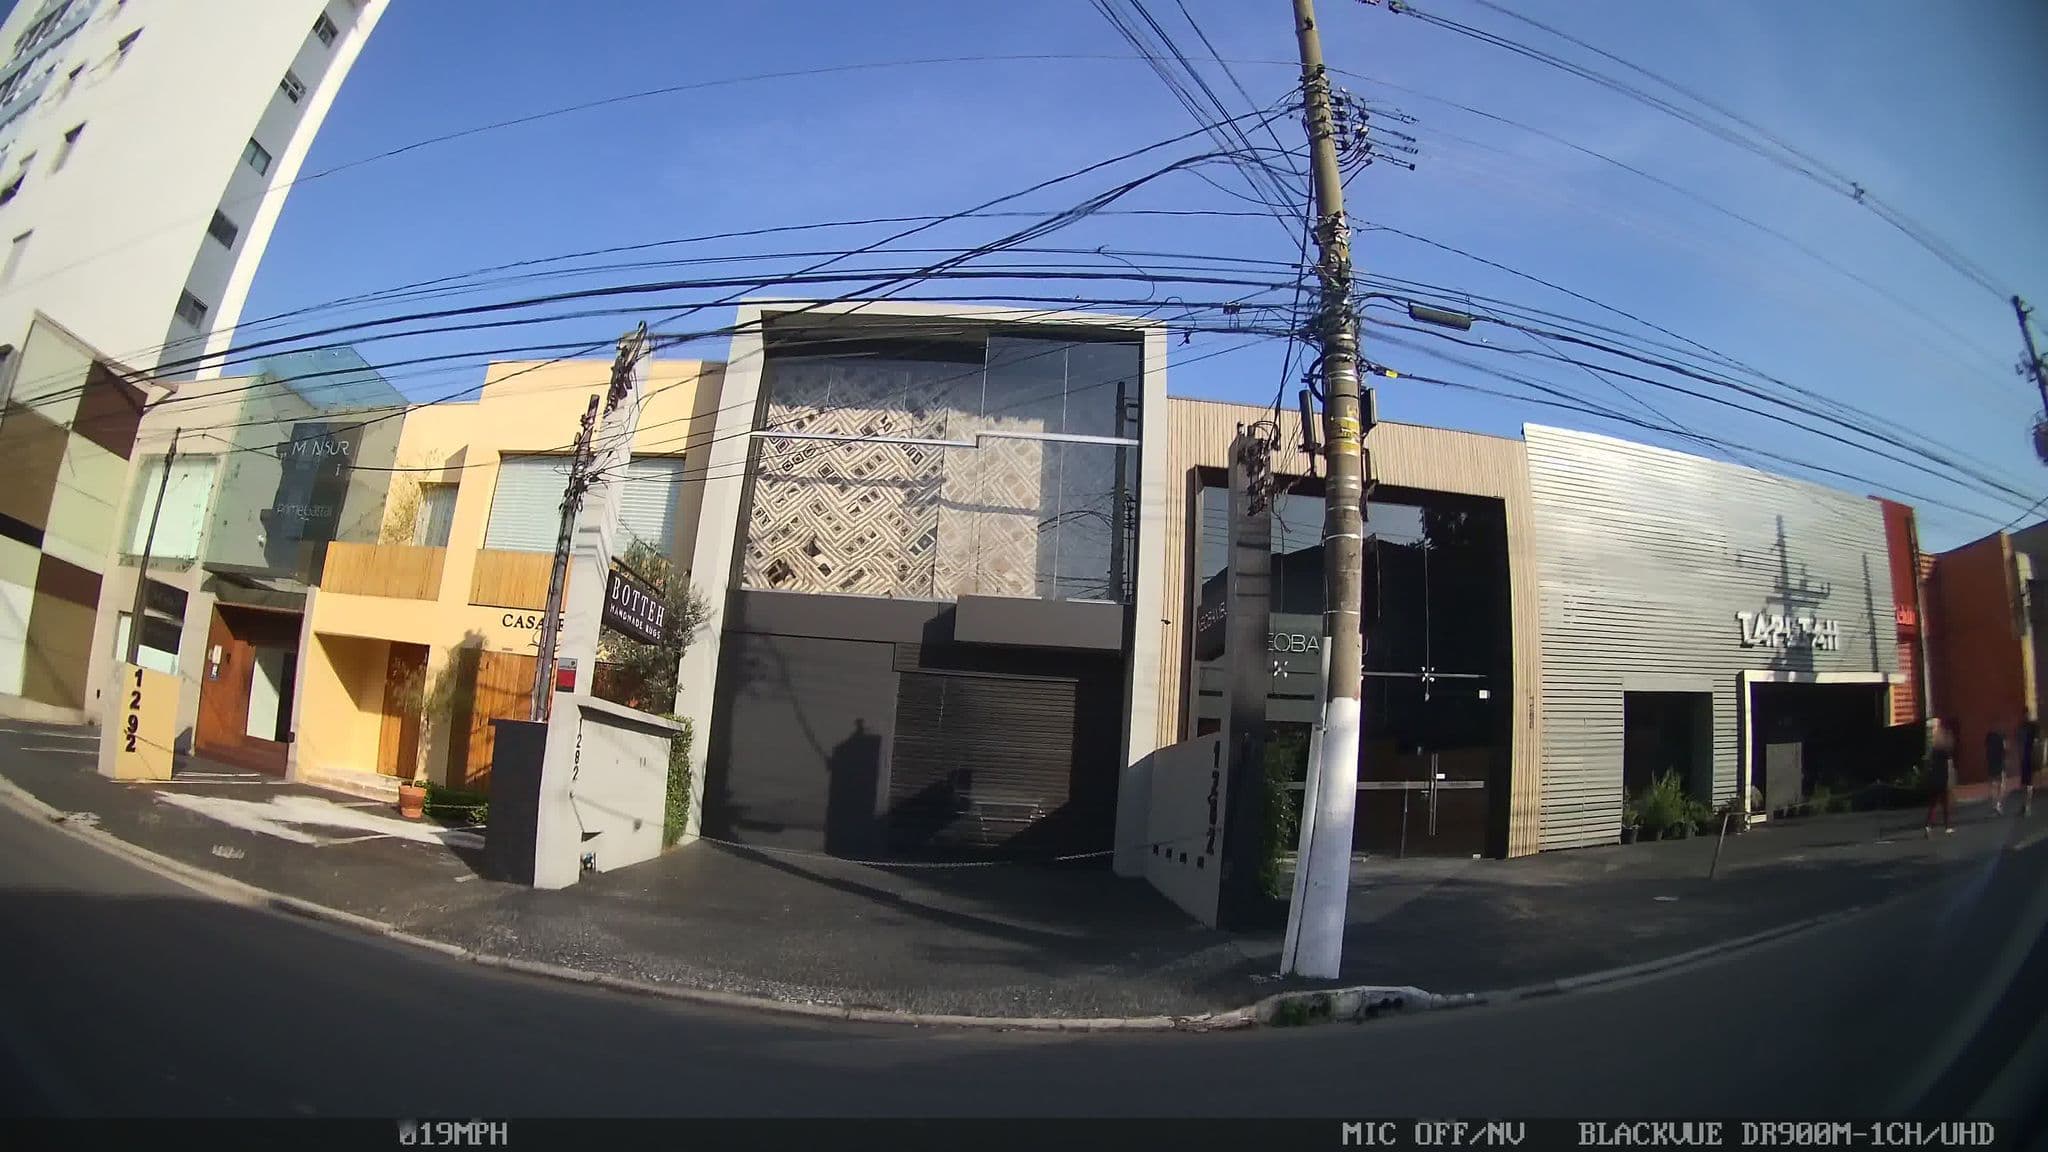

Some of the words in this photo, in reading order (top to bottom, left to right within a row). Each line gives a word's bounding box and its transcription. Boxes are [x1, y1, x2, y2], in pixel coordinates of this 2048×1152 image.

[292, 440, 350, 457] MNSUR
[609, 603, 644, 630] HANDMADE
[645, 624, 662, 641] RUGS
[611, 577, 665, 627] BOTTEH
[125, 669, 143, 753] 1292
[570, 718, 583, 781] 1282
